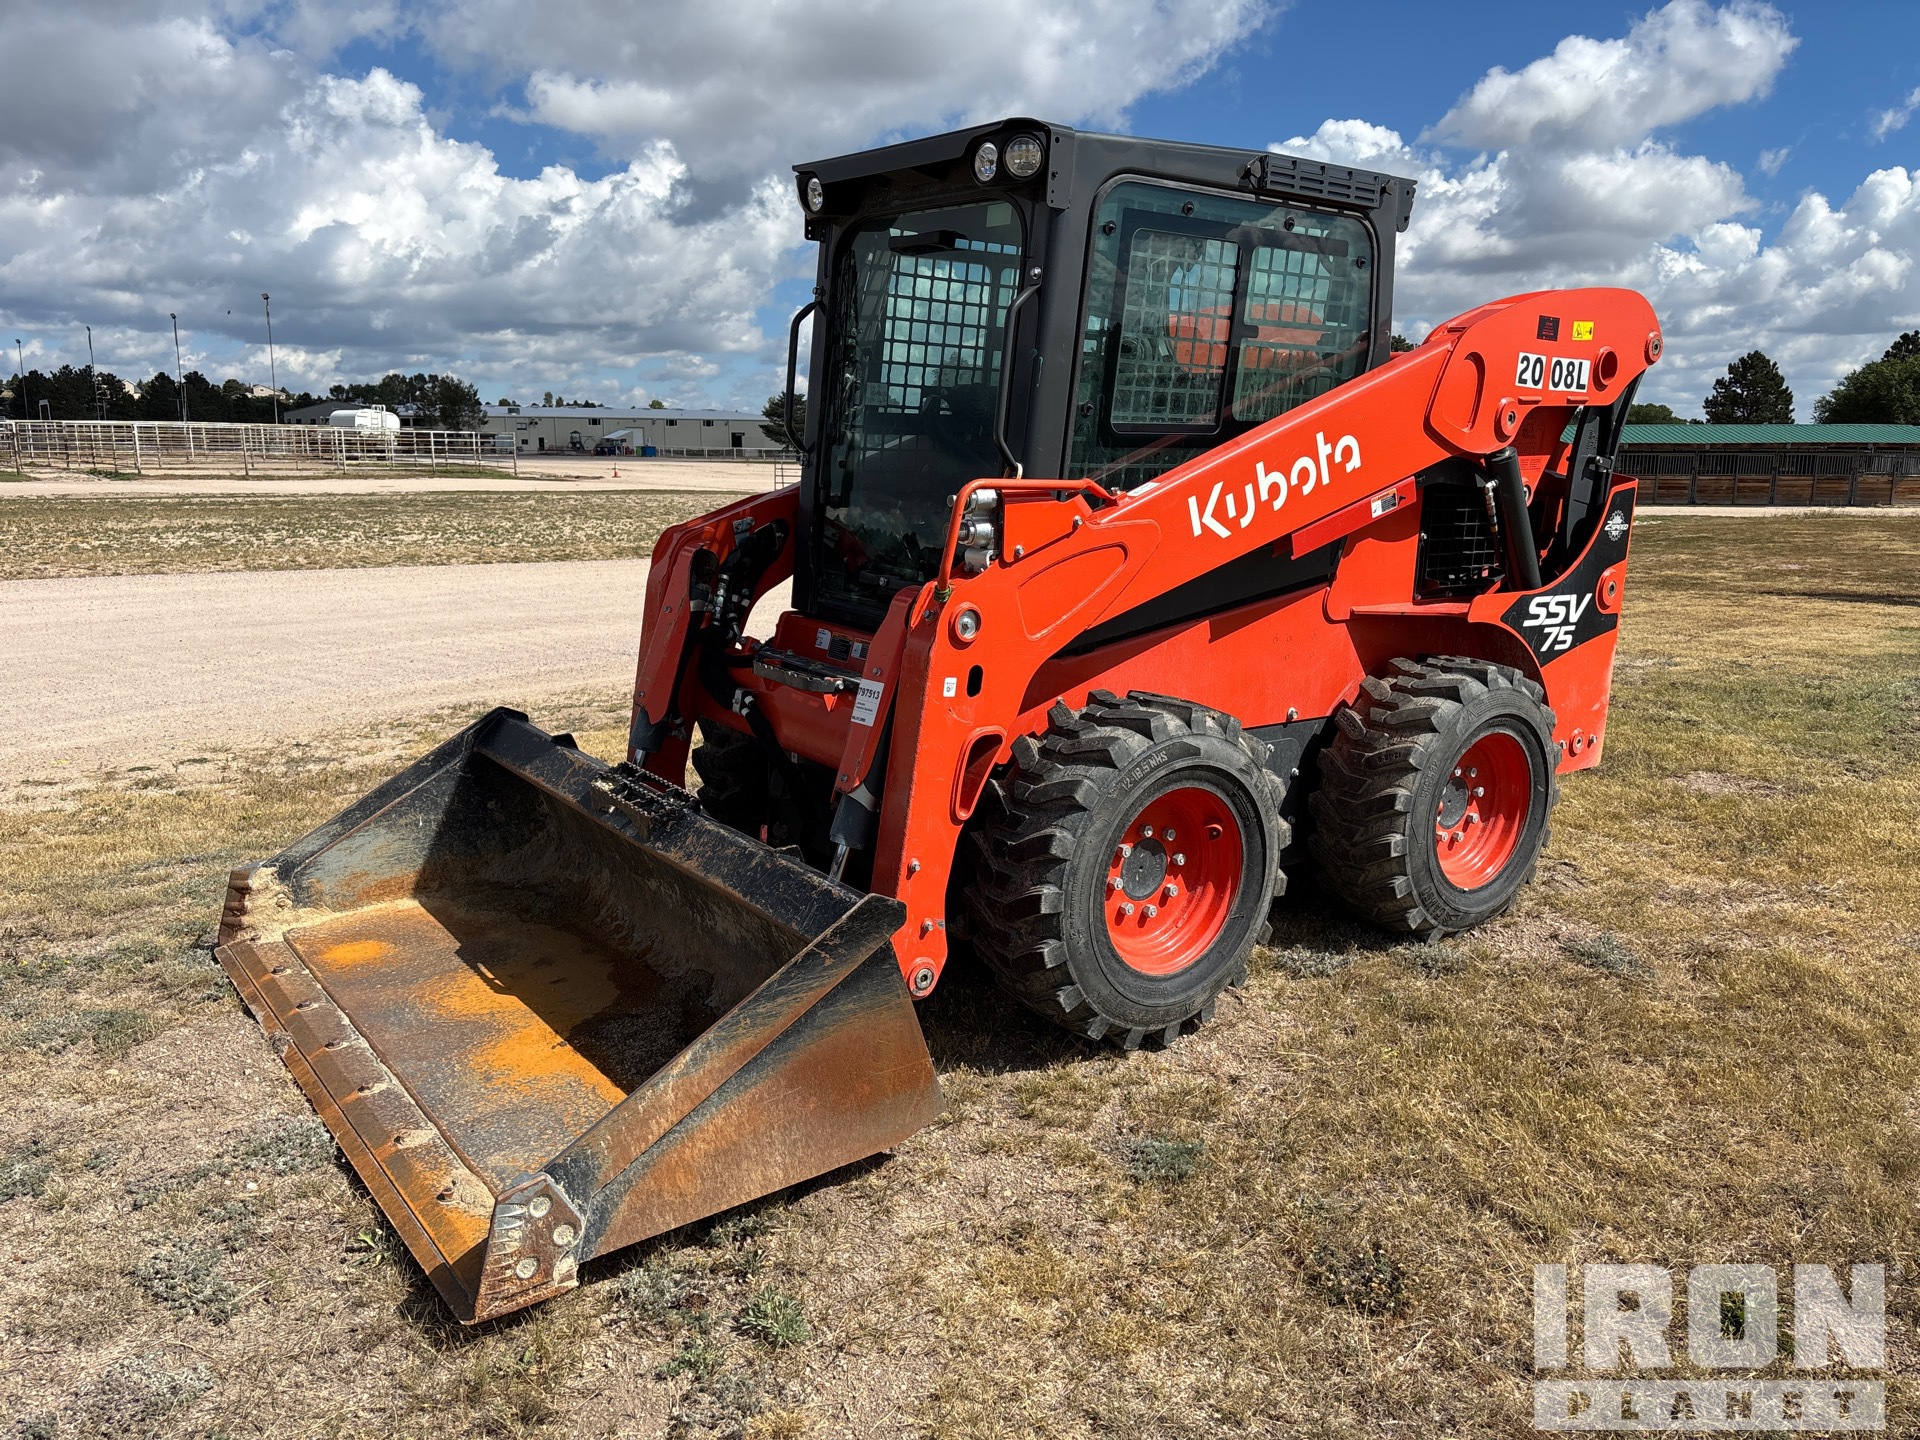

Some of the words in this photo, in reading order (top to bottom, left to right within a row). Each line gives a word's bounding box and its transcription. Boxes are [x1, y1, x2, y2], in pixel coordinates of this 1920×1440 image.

[1518, 355, 1544, 387] 20
[1551, 360, 1586, 391] 08L
[1187, 431, 1362, 539] Kubota
[1523, 593, 1593, 627] SSV
[1540, 625, 1576, 652] 75
[1149, 751, 1168, 768] NHS
